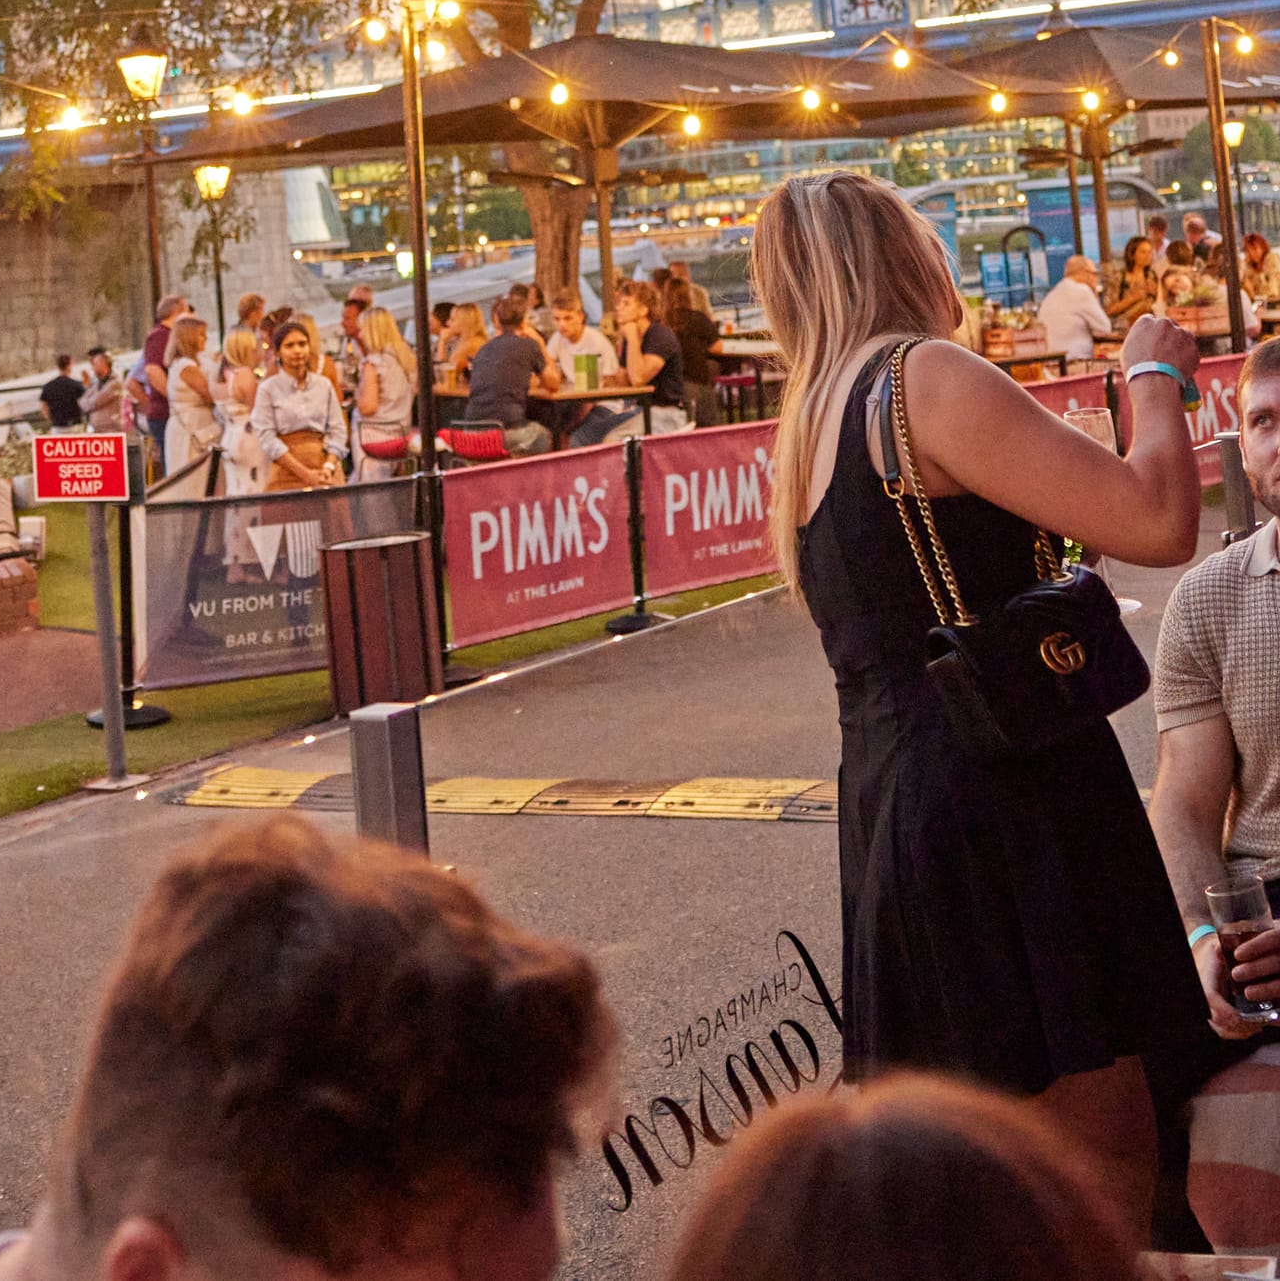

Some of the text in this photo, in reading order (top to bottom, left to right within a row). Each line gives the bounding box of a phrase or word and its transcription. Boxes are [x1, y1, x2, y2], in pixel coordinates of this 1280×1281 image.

[42, 439, 115, 457] CAUTION
[58, 463, 103, 479] SPEED
[60, 479, 103, 495] RAMP
[470, 476, 609, 580] PIMM'S
[524, 584, 548, 601] THE
[550, 576, 585, 595] LAWN
[189, 600, 216, 620] VU
[222, 594, 275, 616] FROM
[280, 589, 313, 608] THE
[225, 623, 326, 648] BAR & KITCH
